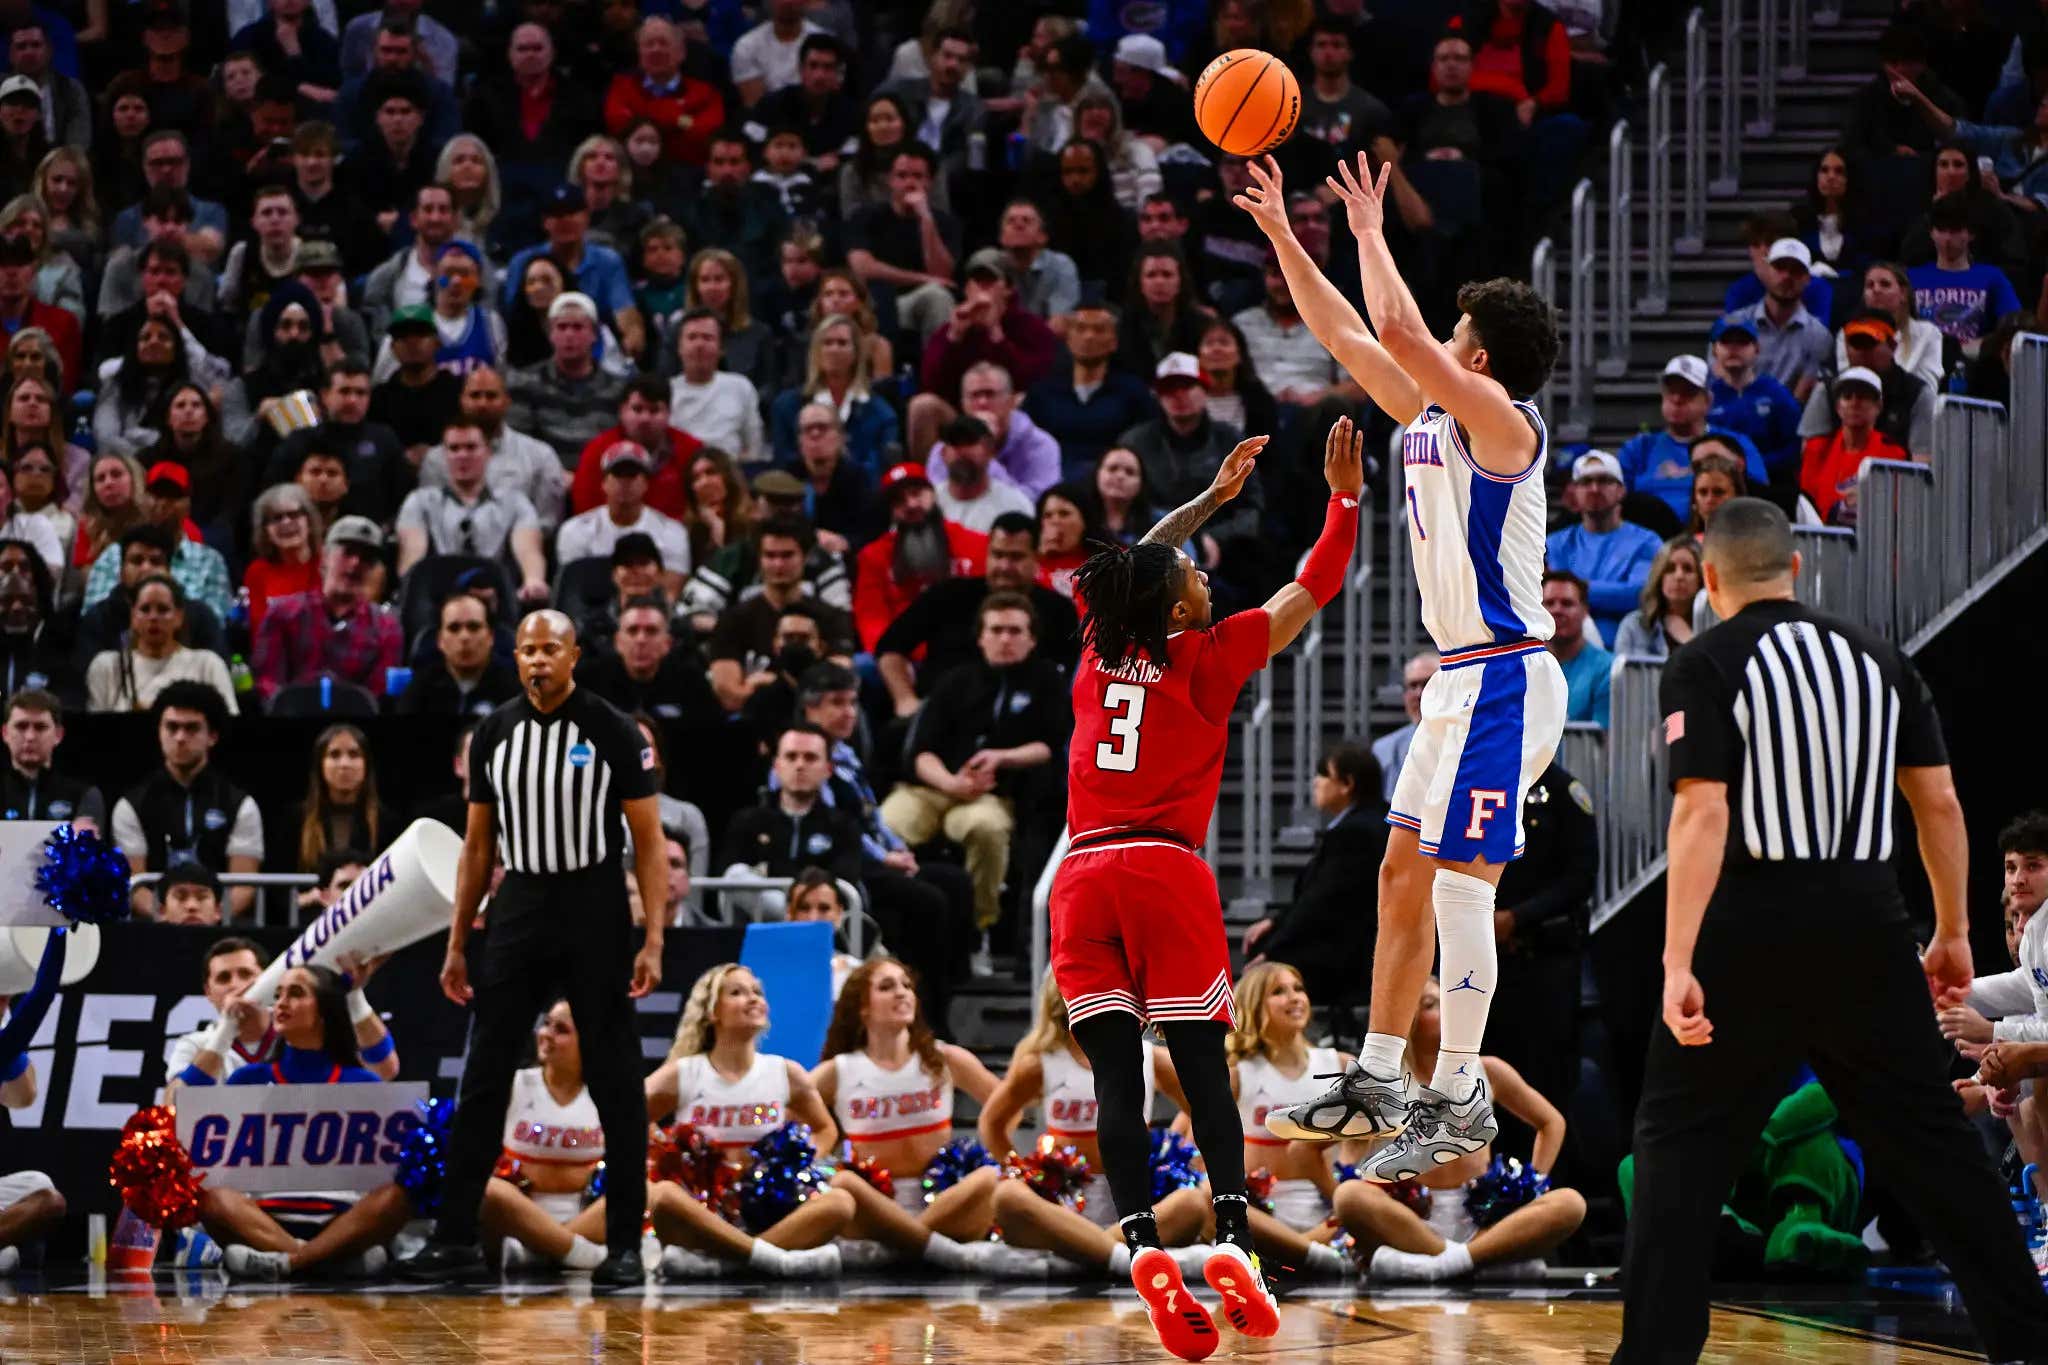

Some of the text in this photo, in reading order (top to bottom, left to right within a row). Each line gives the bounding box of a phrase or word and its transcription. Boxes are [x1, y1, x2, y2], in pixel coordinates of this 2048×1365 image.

[1408, 485, 1426, 540] 1
[1096, 682, 1145, 772] 3
[1465, 788, 1506, 839] F
[190, 1110, 421, 1168] GATORS
